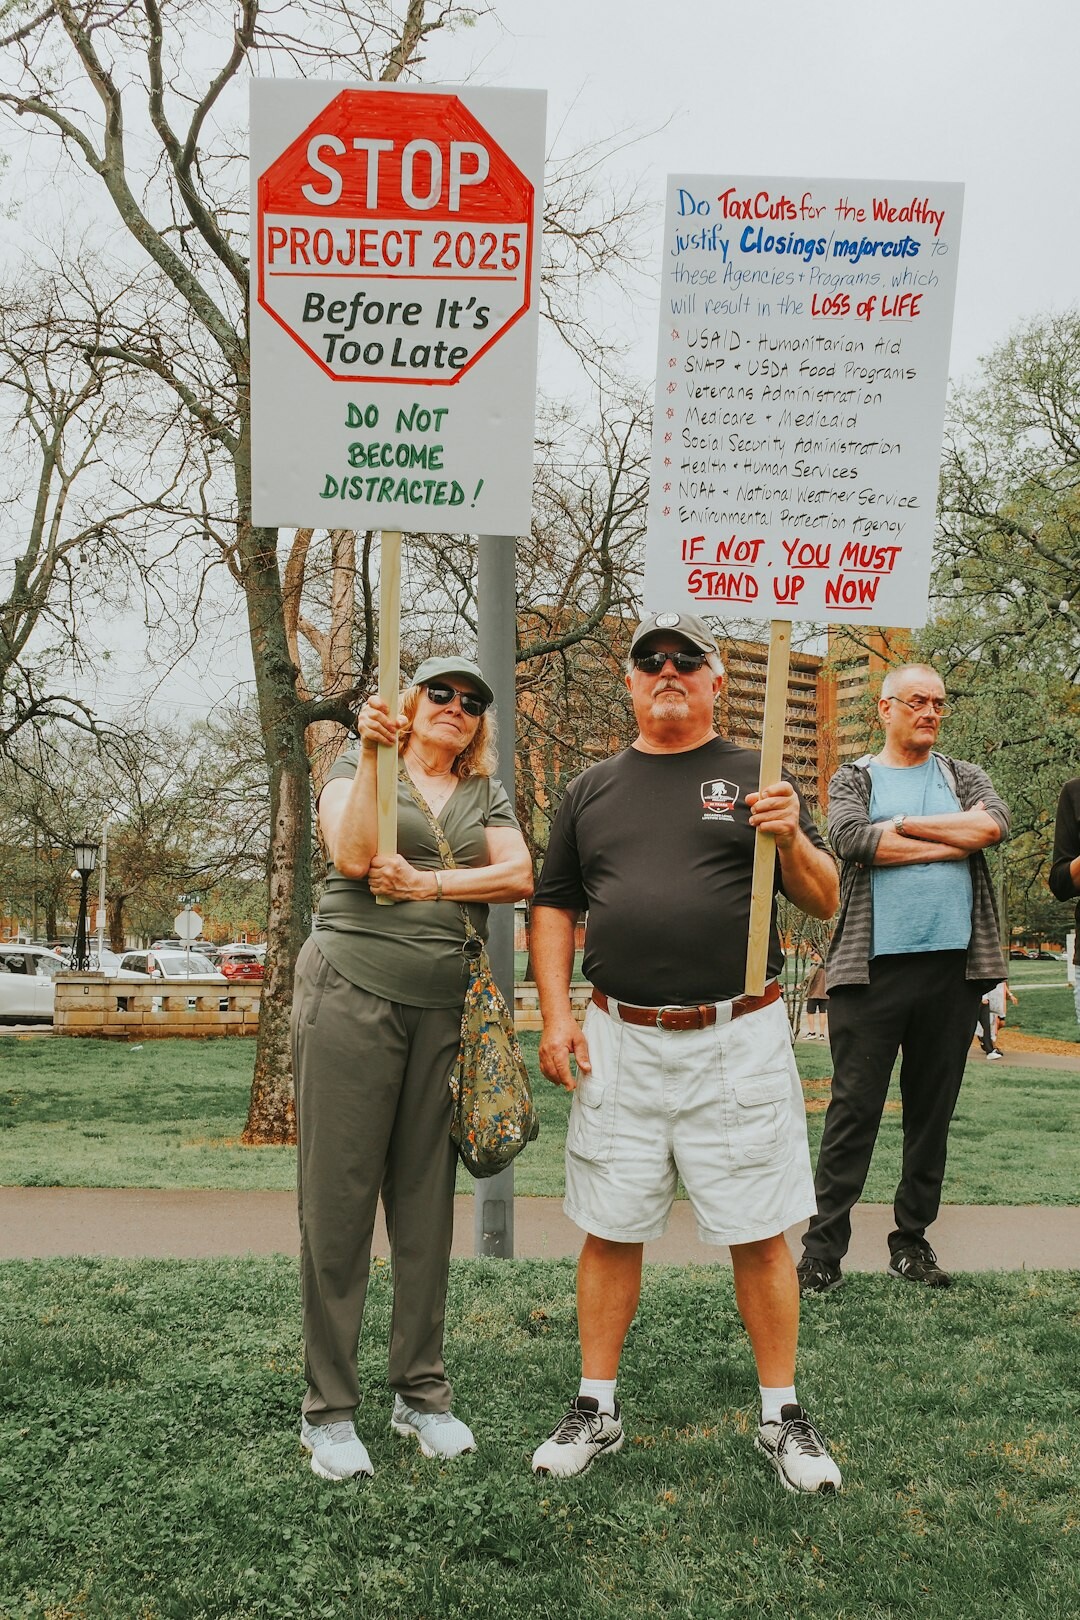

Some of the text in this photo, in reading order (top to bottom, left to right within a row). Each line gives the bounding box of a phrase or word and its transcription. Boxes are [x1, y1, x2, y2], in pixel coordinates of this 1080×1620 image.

[301, 133, 490, 212] STOP
[677, 188, 711, 217] Do
[799, 192, 826, 221] for
[834, 197, 867, 223] the
[872, 197, 945, 237] Wealthy
[267, 227, 521, 270] PROJECT 2025
[670, 223, 729, 264] justify
[931, 239, 949, 257] to
[671, 262, 717, 285] these
[723, 261, 794, 291] Agencies
[890, 264, 939, 288] which
[302, 292, 490, 331] Before It's
[671, 293, 696, 315] will
[704, 294, 751, 315] result
[758, 296, 771, 316] in
[777, 295, 804, 316] the
[856, 294, 877, 322] of
[881, 293, 923, 317] LIFE
[322, 333, 468, 369] Too Late
[686, 328, 741, 351] USAID
[758, 333, 864, 353] Humanitarian
[684, 356, 725, 374] SNAP
[747, 359, 789, 378] USDA
[798, 358, 835, 378] Food
[844, 361, 917, 384] Programs
[686, 380, 882, 405] Veterans Administration
[344, 402, 449, 433] DO NOT
[685, 407, 756, 426] Medicare
[779, 409, 857, 428] Medicaid
[347, 442, 444, 470] BECOME
[681, 428, 901, 458] Social Security Administration
[680, 457, 727, 475] Health
[743, 457, 788, 477] Human
[791, 460, 858, 479] Services
[319, 474, 484, 508] DISTRACTED!
[678, 479, 716, 500] NOAA
[736, 484, 792, 502] National
[797, 486, 856, 505] Weather
[858, 488, 921, 509] Service
[678, 506, 906, 541] Environmental Protection Agency
[681, 536, 705, 561] IF
[782, 538, 831, 567] YOU
[839, 541, 902, 570] MUST
[688, 569, 881, 604] STAND UP NOW
